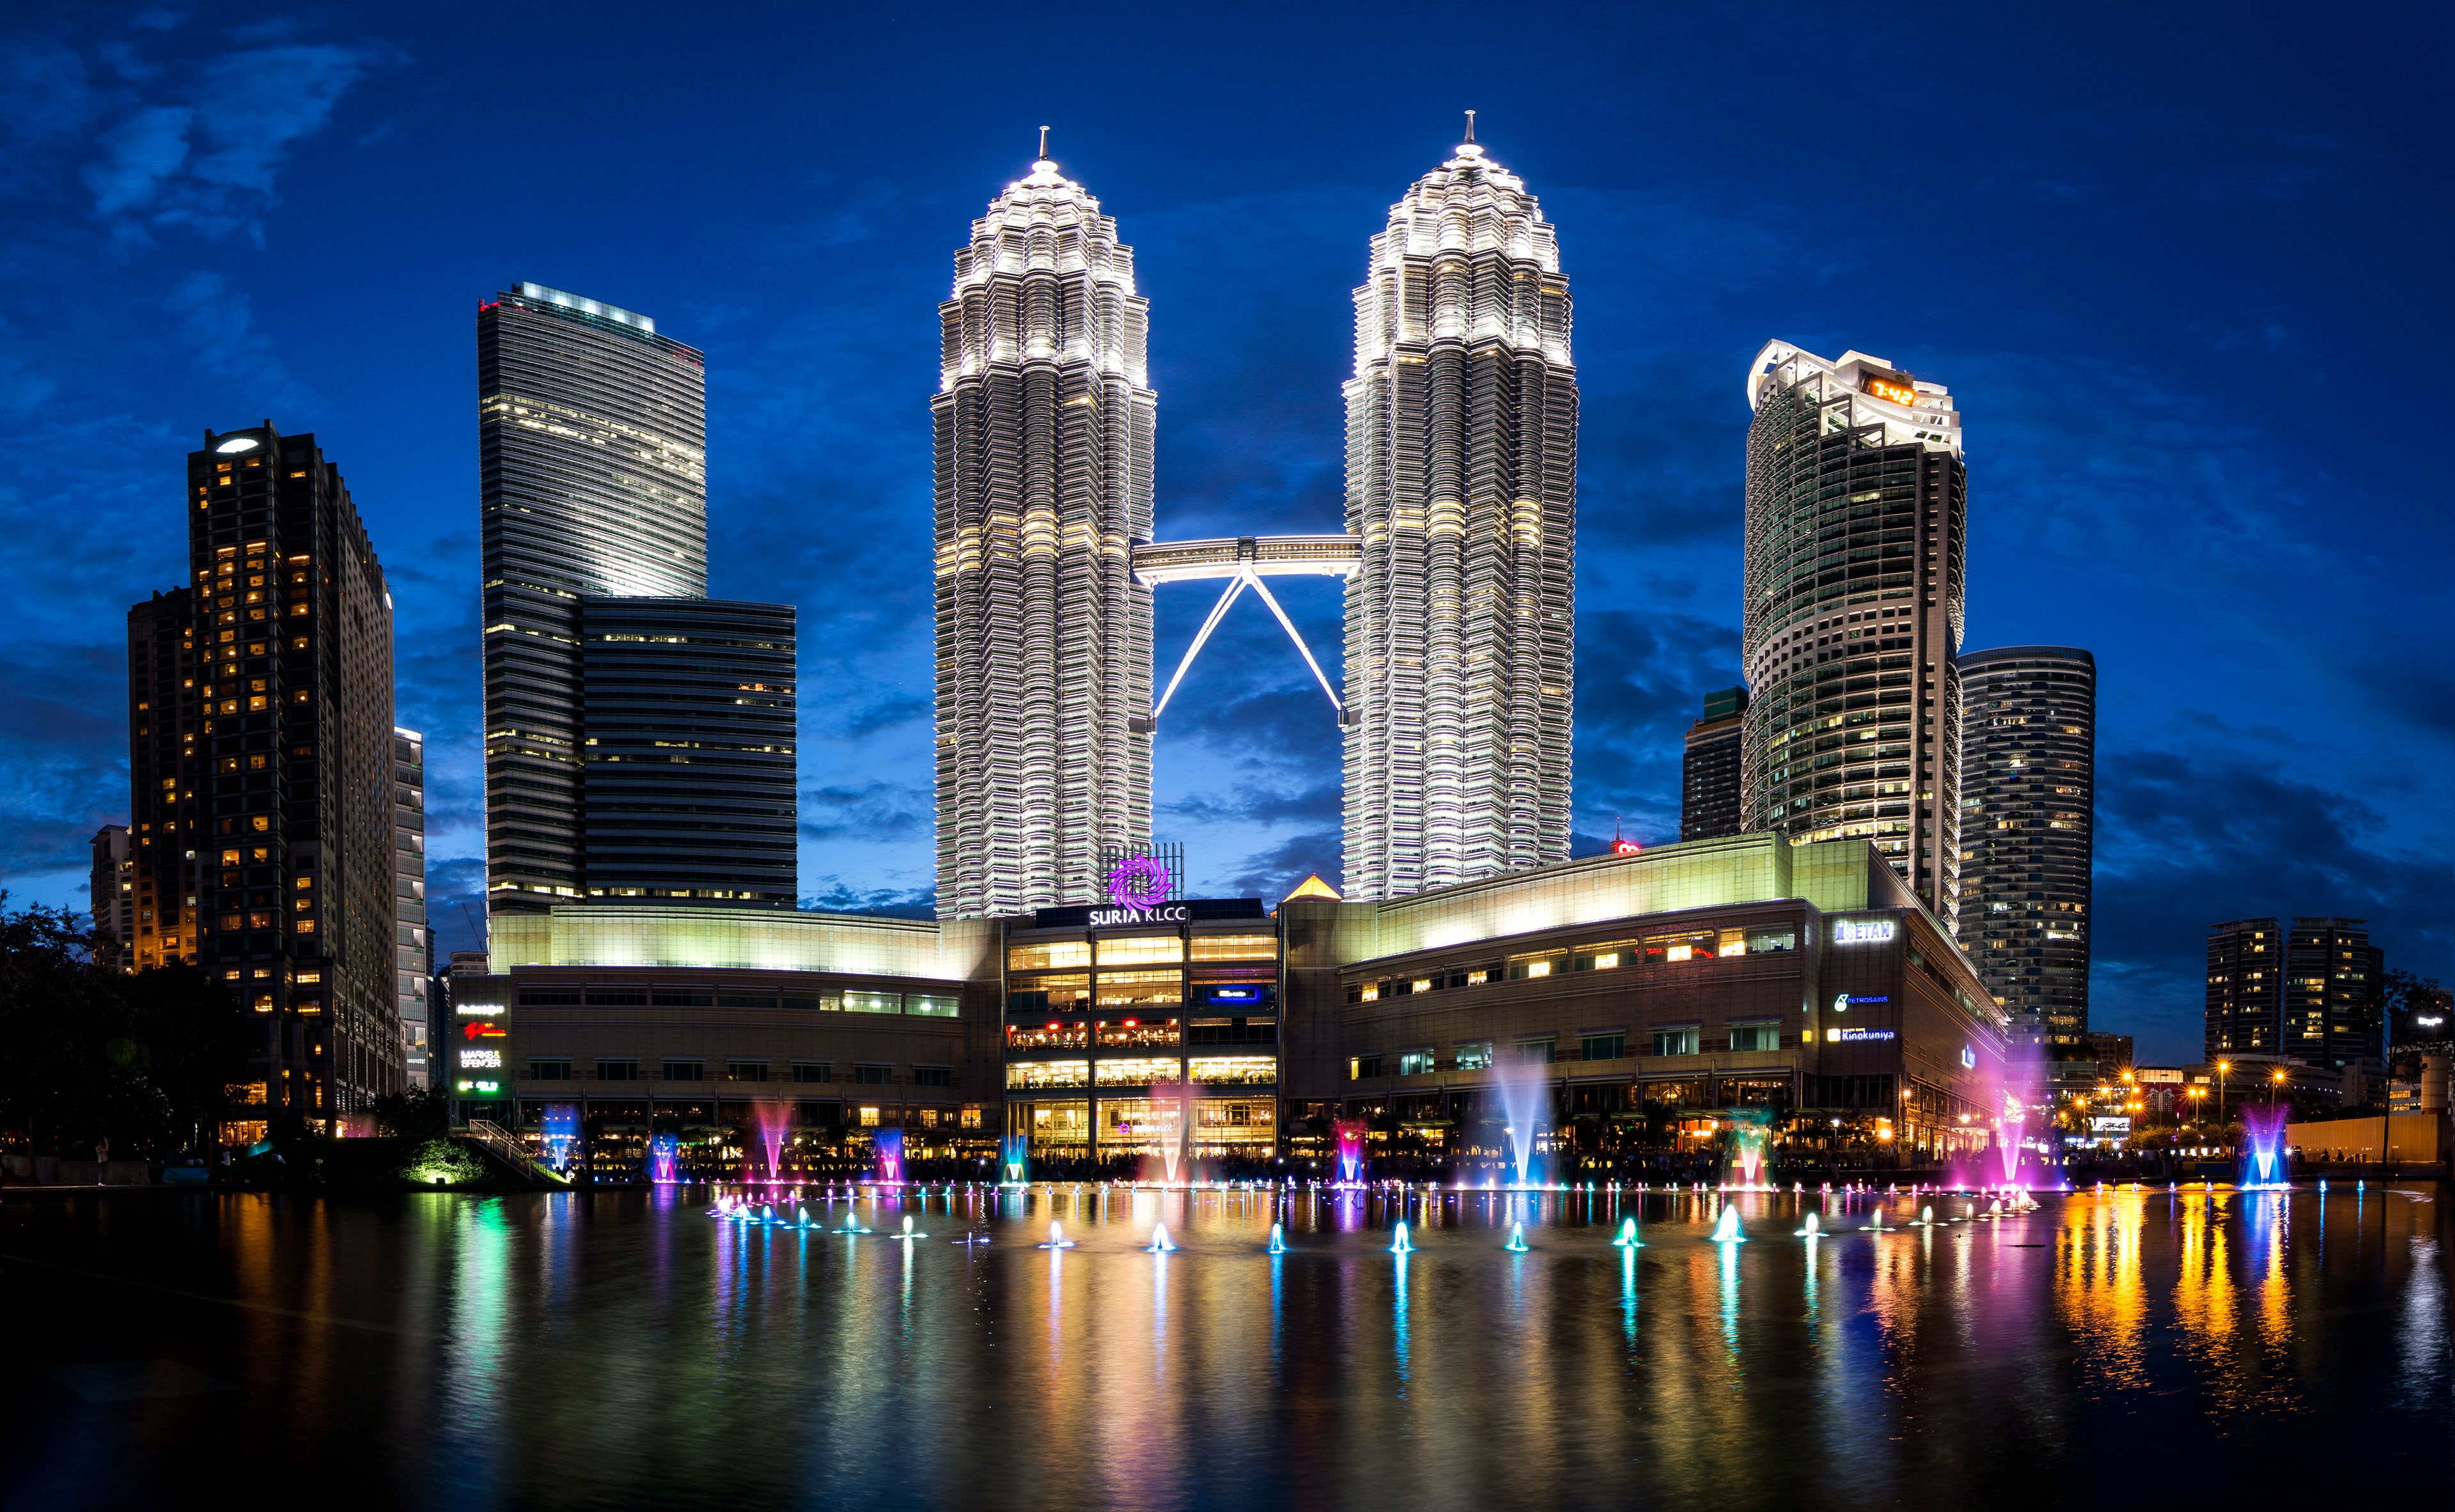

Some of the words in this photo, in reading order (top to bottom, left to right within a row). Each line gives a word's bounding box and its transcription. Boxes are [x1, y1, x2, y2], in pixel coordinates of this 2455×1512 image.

[1874, 382, 1913, 405] 7:42
[1089, 908, 1141, 926] SURIA
[1145, 907, 1187, 922] KLCC
[1842, 1029, 1894, 1041] Kinokuniya
[460, 1050, 494, 1059] MARKS
[494, 1050, 501, 1059] &
[461, 1059, 501, 1068] SPENCER
